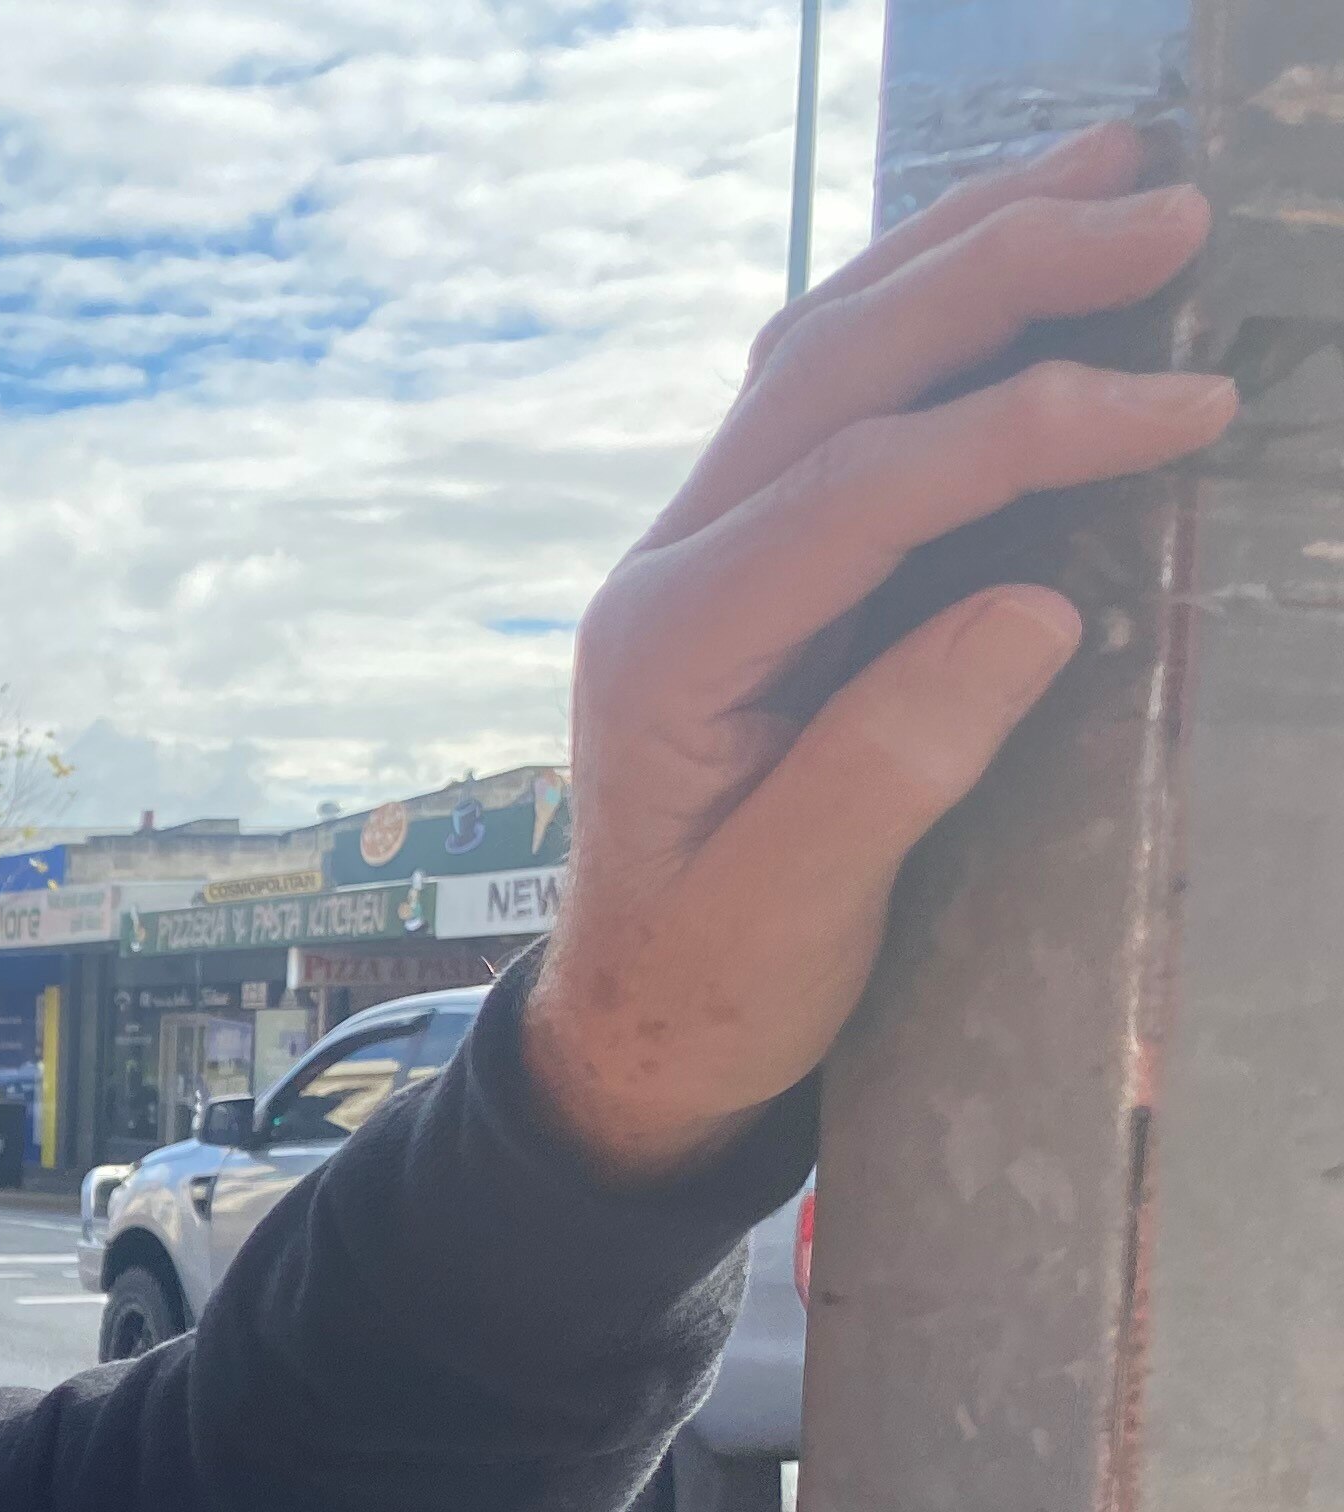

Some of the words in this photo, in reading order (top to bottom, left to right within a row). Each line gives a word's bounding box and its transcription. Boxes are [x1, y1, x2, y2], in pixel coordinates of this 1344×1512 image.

[210, 873, 318, 899] COSMOPOLITAN
[156, 906, 227, 951] PIZZERIA
[250, 900, 302, 944] PASTA
[306, 891, 389, 938] KITCHEN
